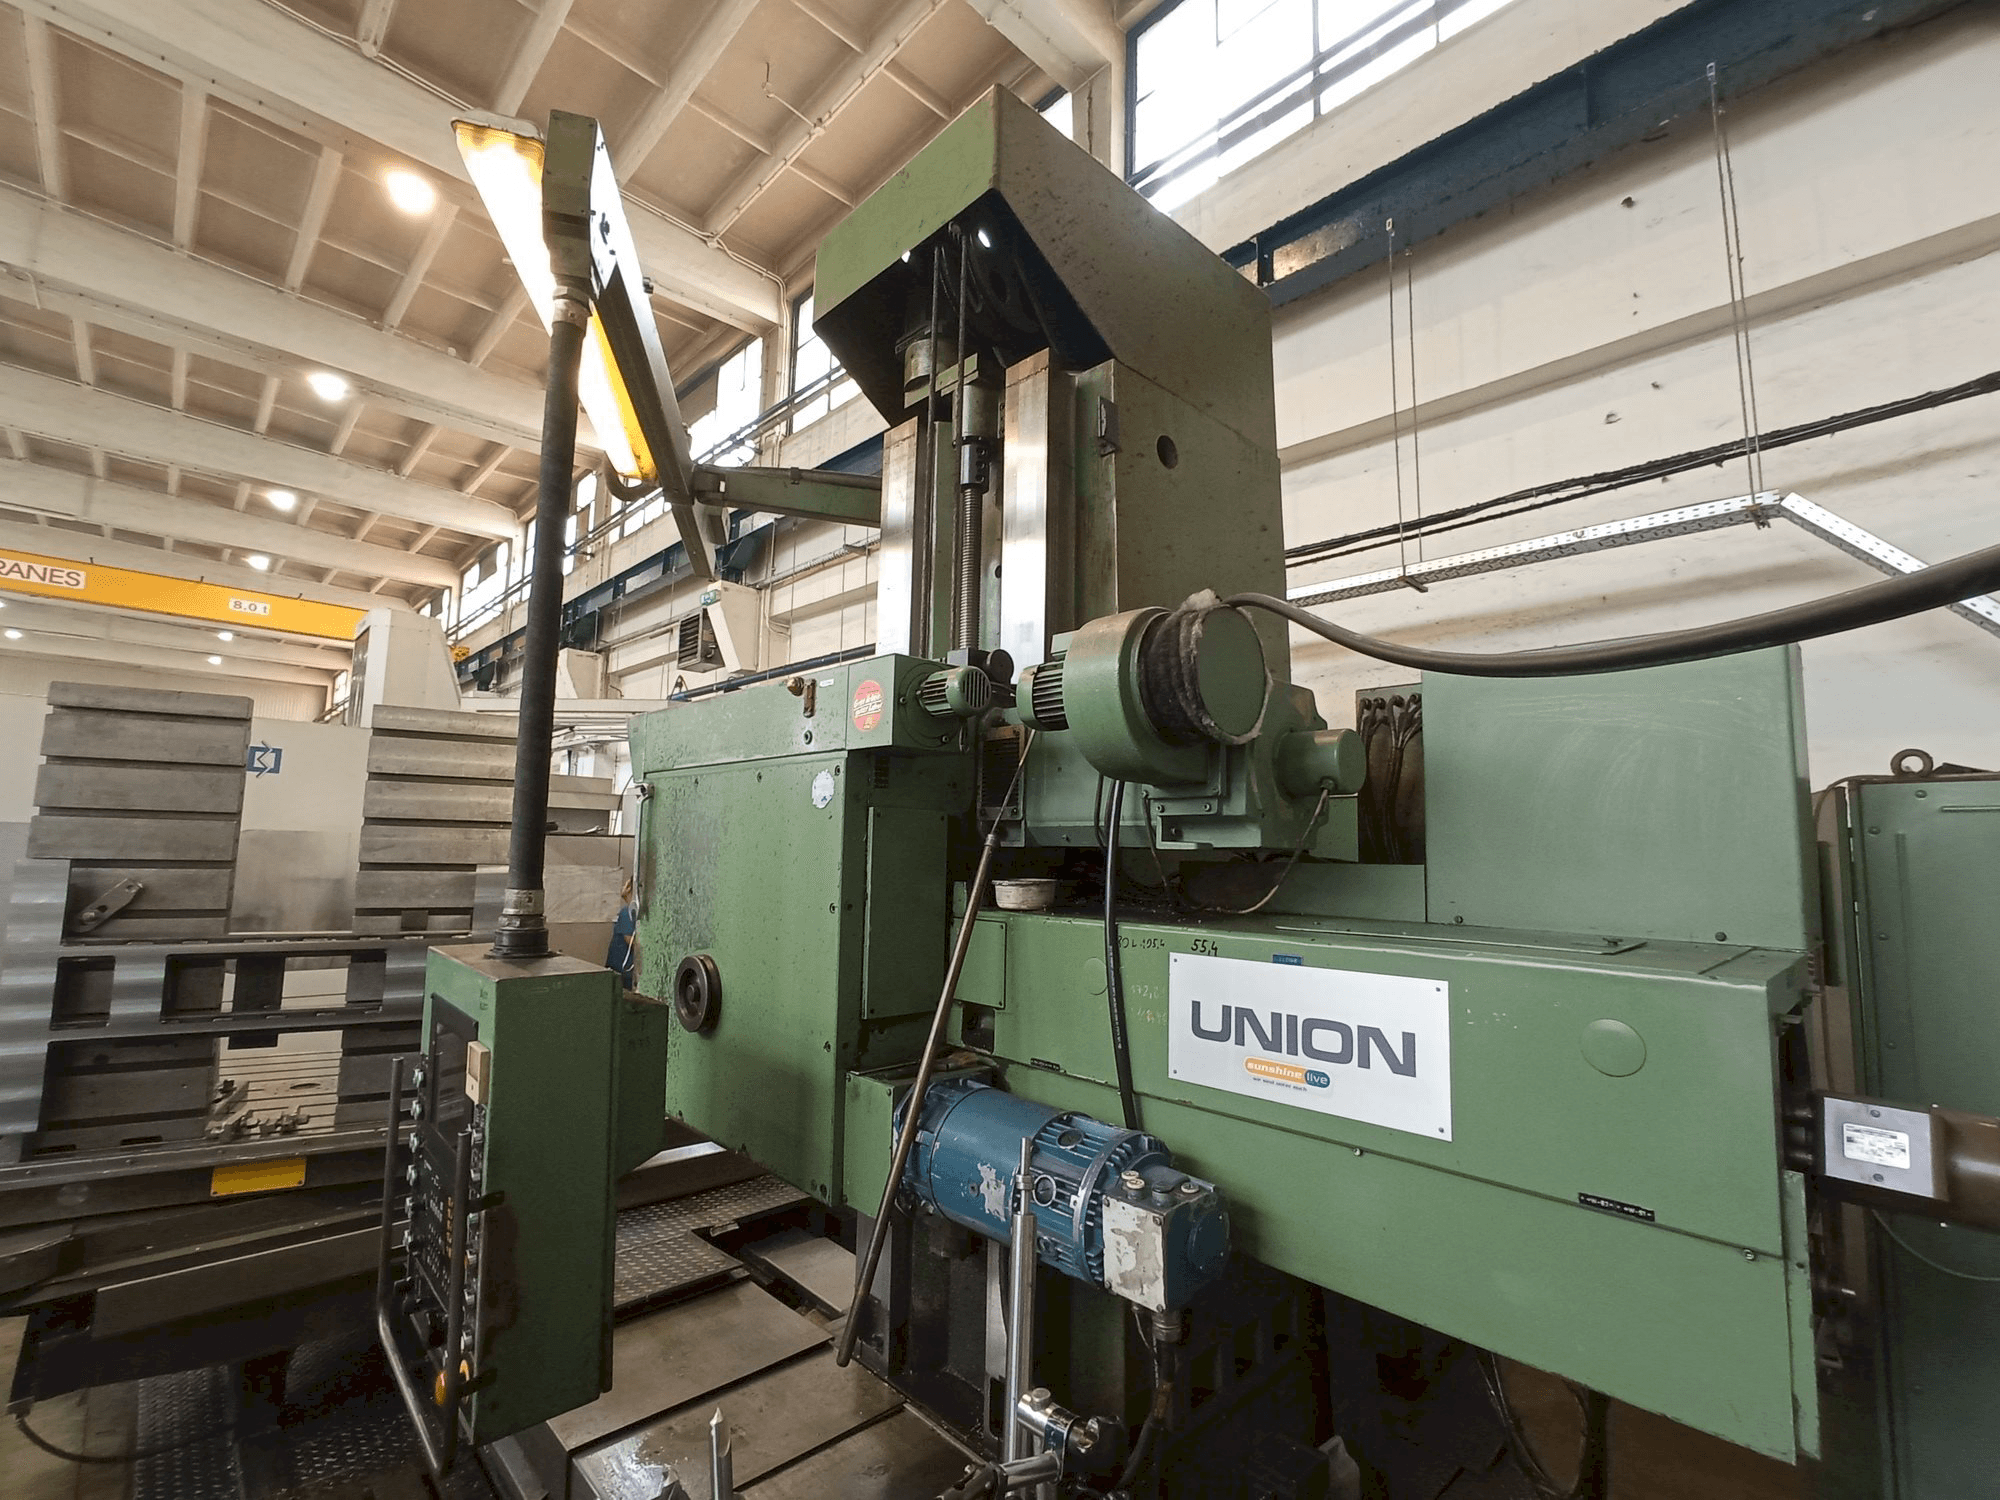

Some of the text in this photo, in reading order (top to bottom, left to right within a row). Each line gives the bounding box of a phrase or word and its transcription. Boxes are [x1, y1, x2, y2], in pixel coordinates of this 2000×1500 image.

[233, 600, 257, 612] 8.0
[1190, 938, 1219, 956] 55,4
[1191, 1000, 1417, 1078] UNION
[1247, 1061, 1303, 1080] sunshine
[1306, 1071, 1328, 1085] live
